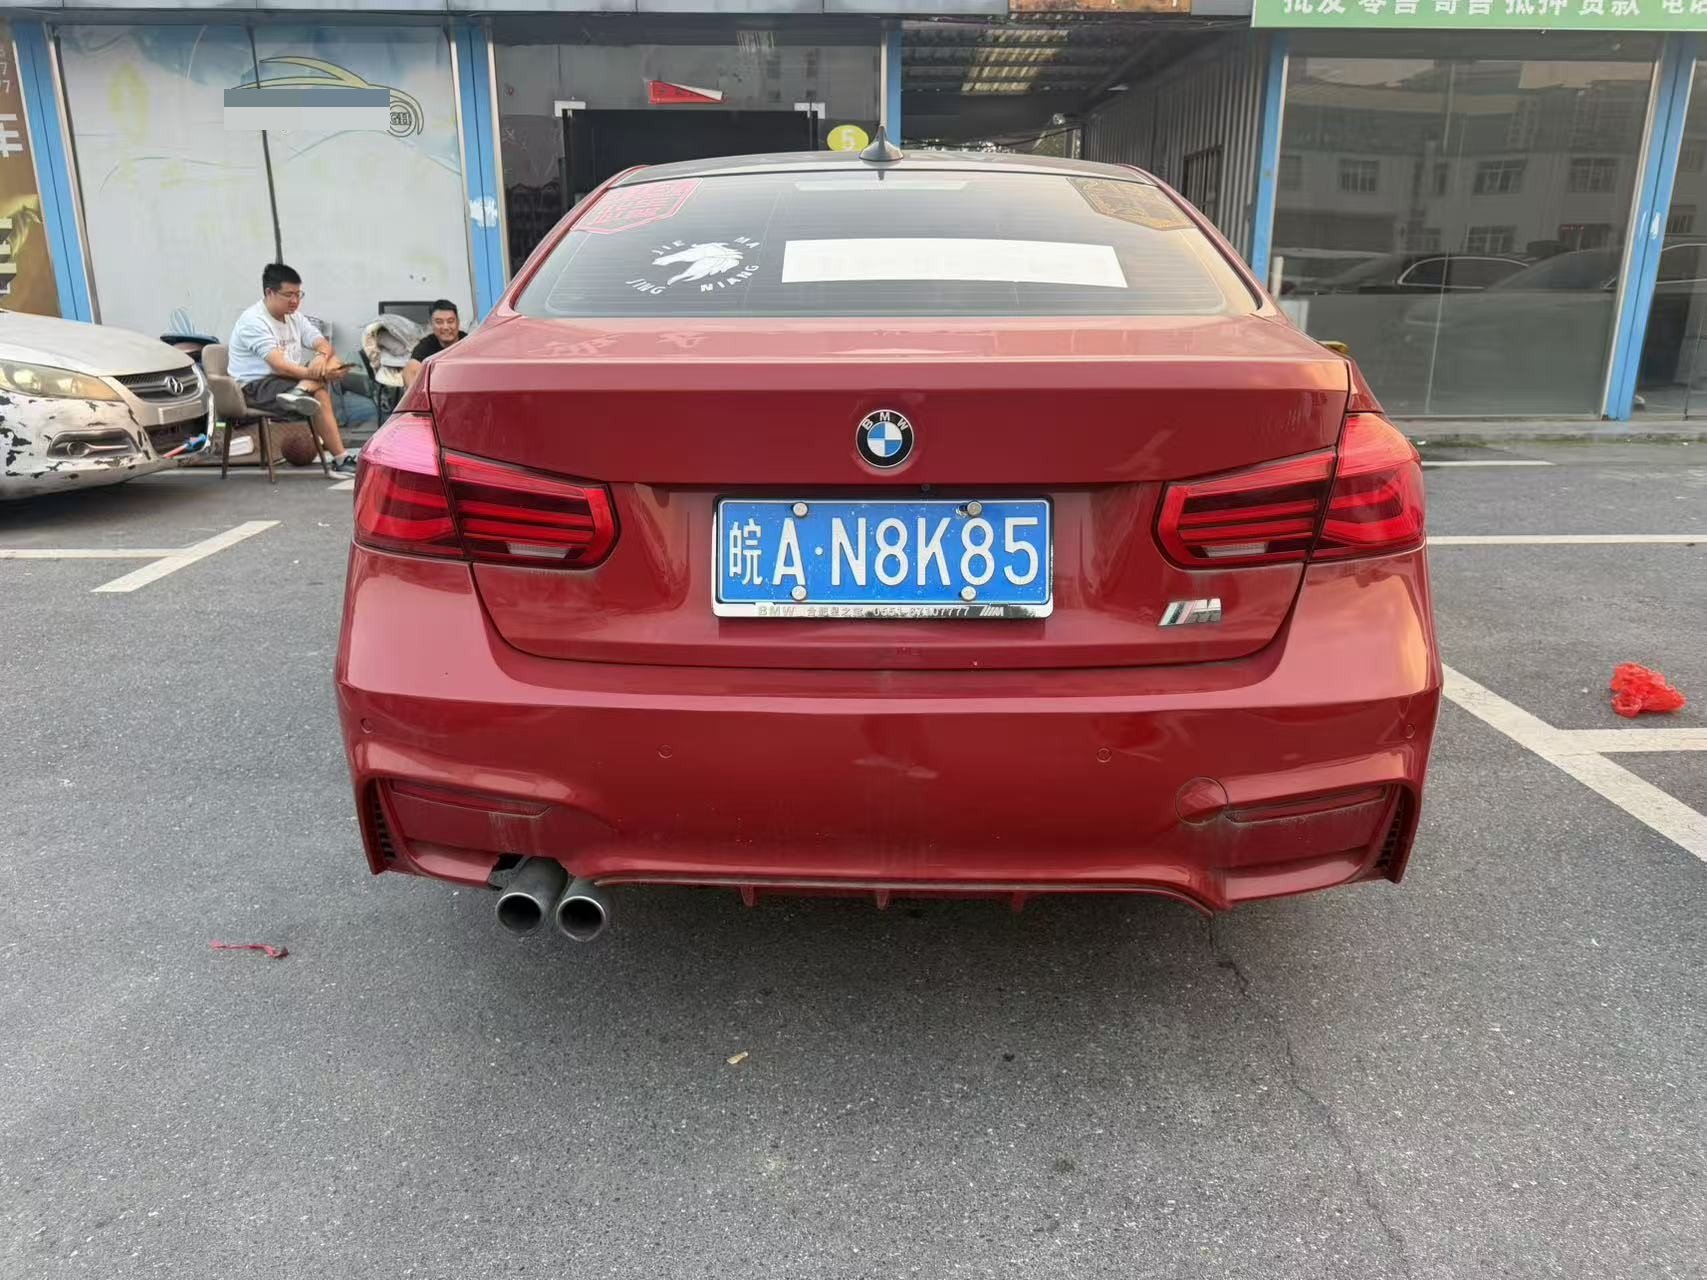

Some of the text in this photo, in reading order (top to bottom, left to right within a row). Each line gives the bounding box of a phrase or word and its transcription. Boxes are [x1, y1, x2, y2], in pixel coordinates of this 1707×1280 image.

[841, 130, 855, 151] 5
[625, 264, 760, 295] JING NIANG
[861, 411, 908, 430] BMW
[758, 606, 796, 616] BMW
